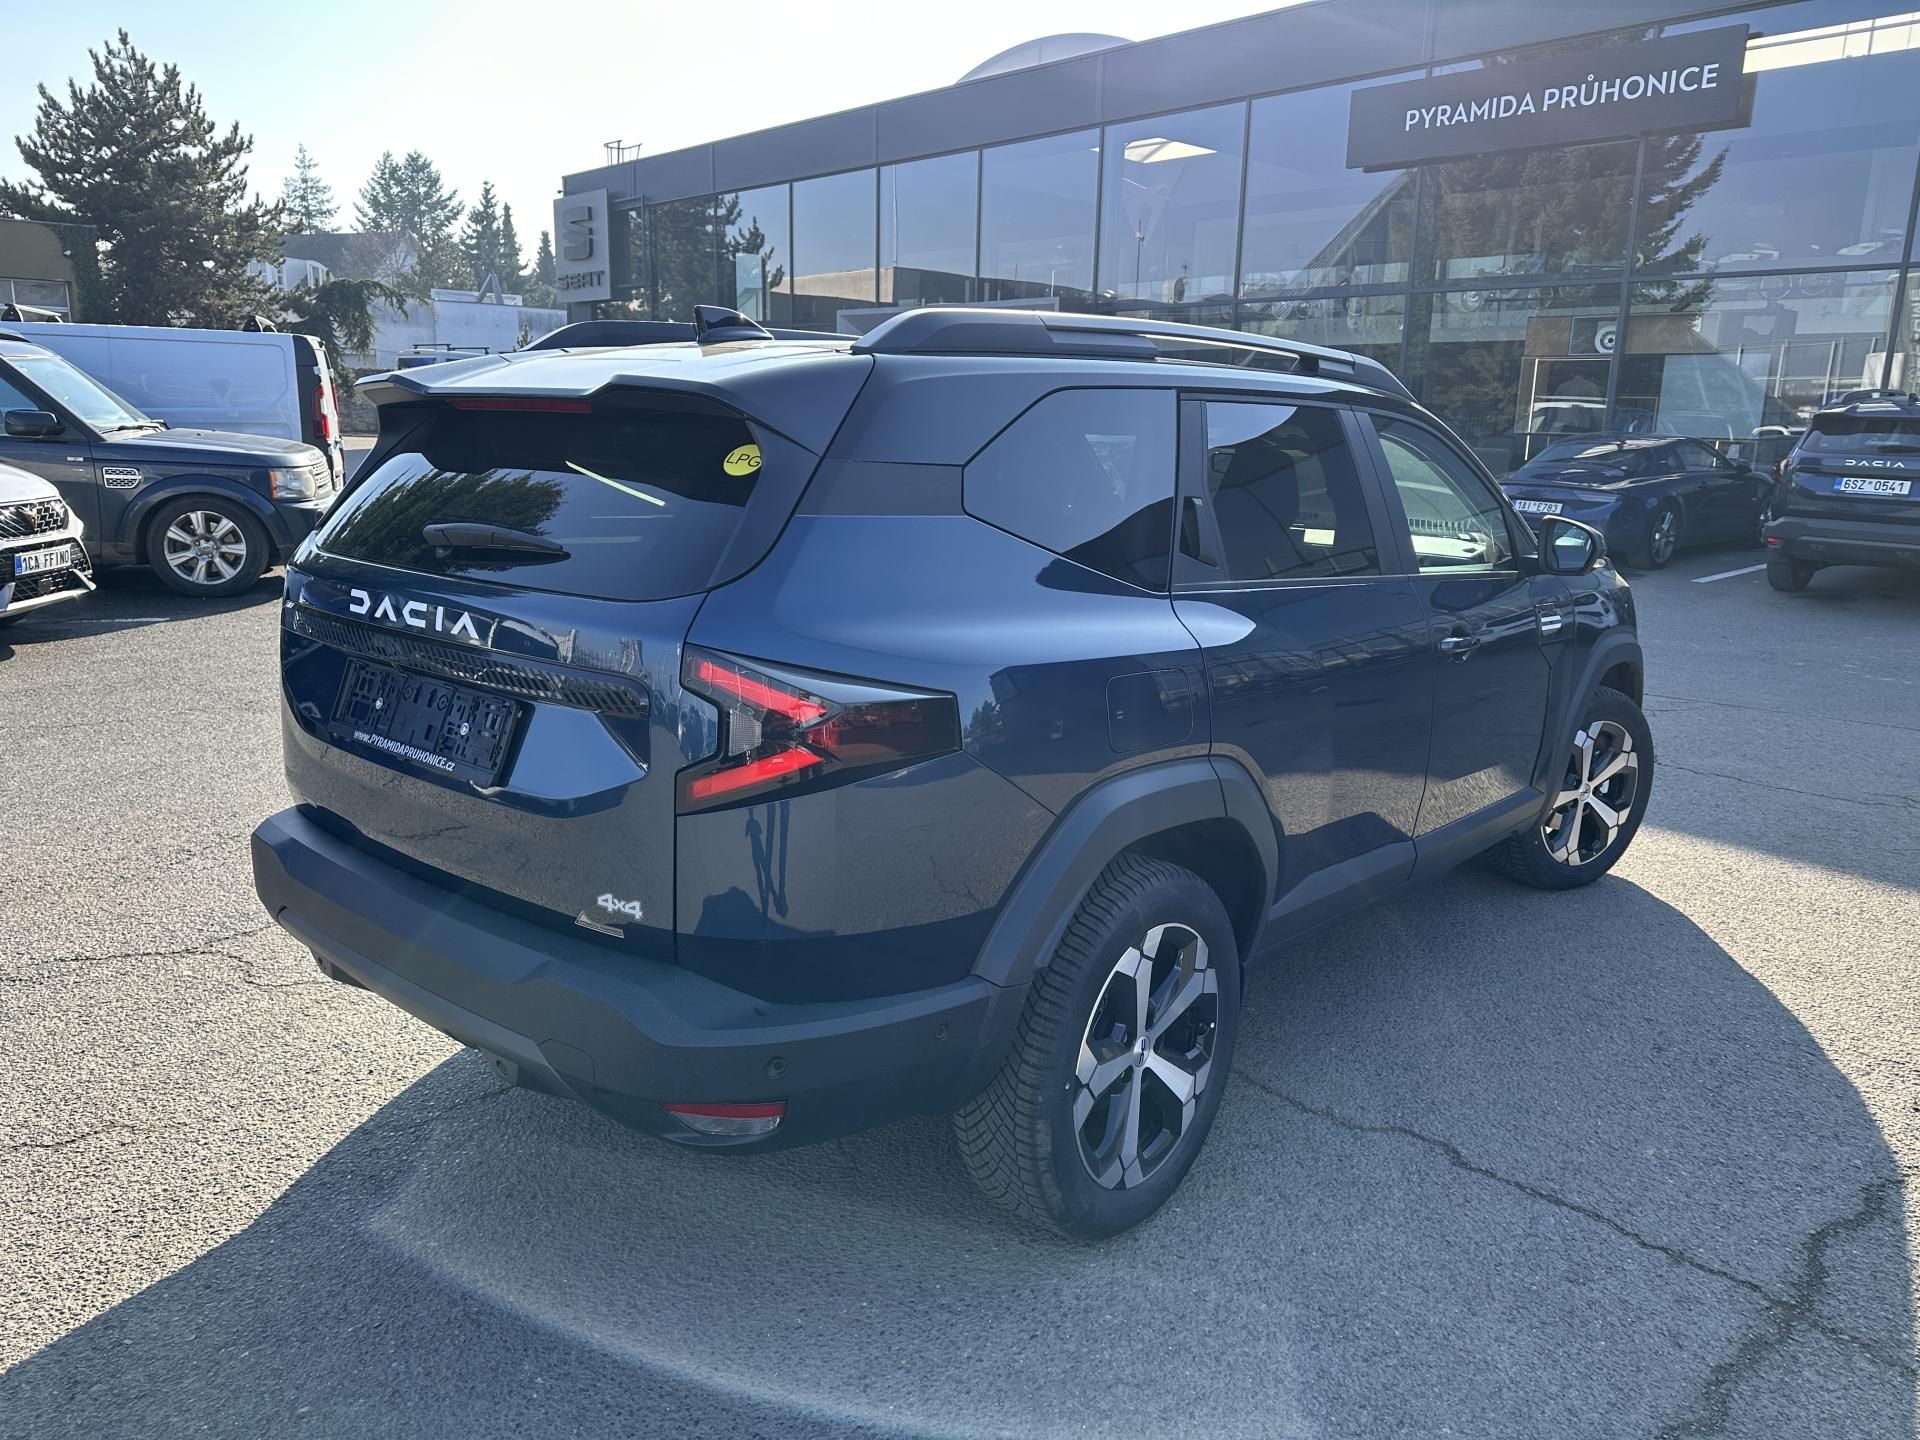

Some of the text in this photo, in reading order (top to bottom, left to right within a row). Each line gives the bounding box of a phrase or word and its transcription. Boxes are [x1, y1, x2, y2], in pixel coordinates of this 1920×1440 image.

[1405, 63, 1720, 131] PYRAMIDA PRŮHONICE
[558, 270, 605, 290] SEAT
[726, 452, 761, 468] LPG
[1845, 459, 1905, 468] DACIA
[22, 556, 40, 572] 1CA
[350, 588, 479, 640] DACIA
[597, 893, 643, 919] 4x4
